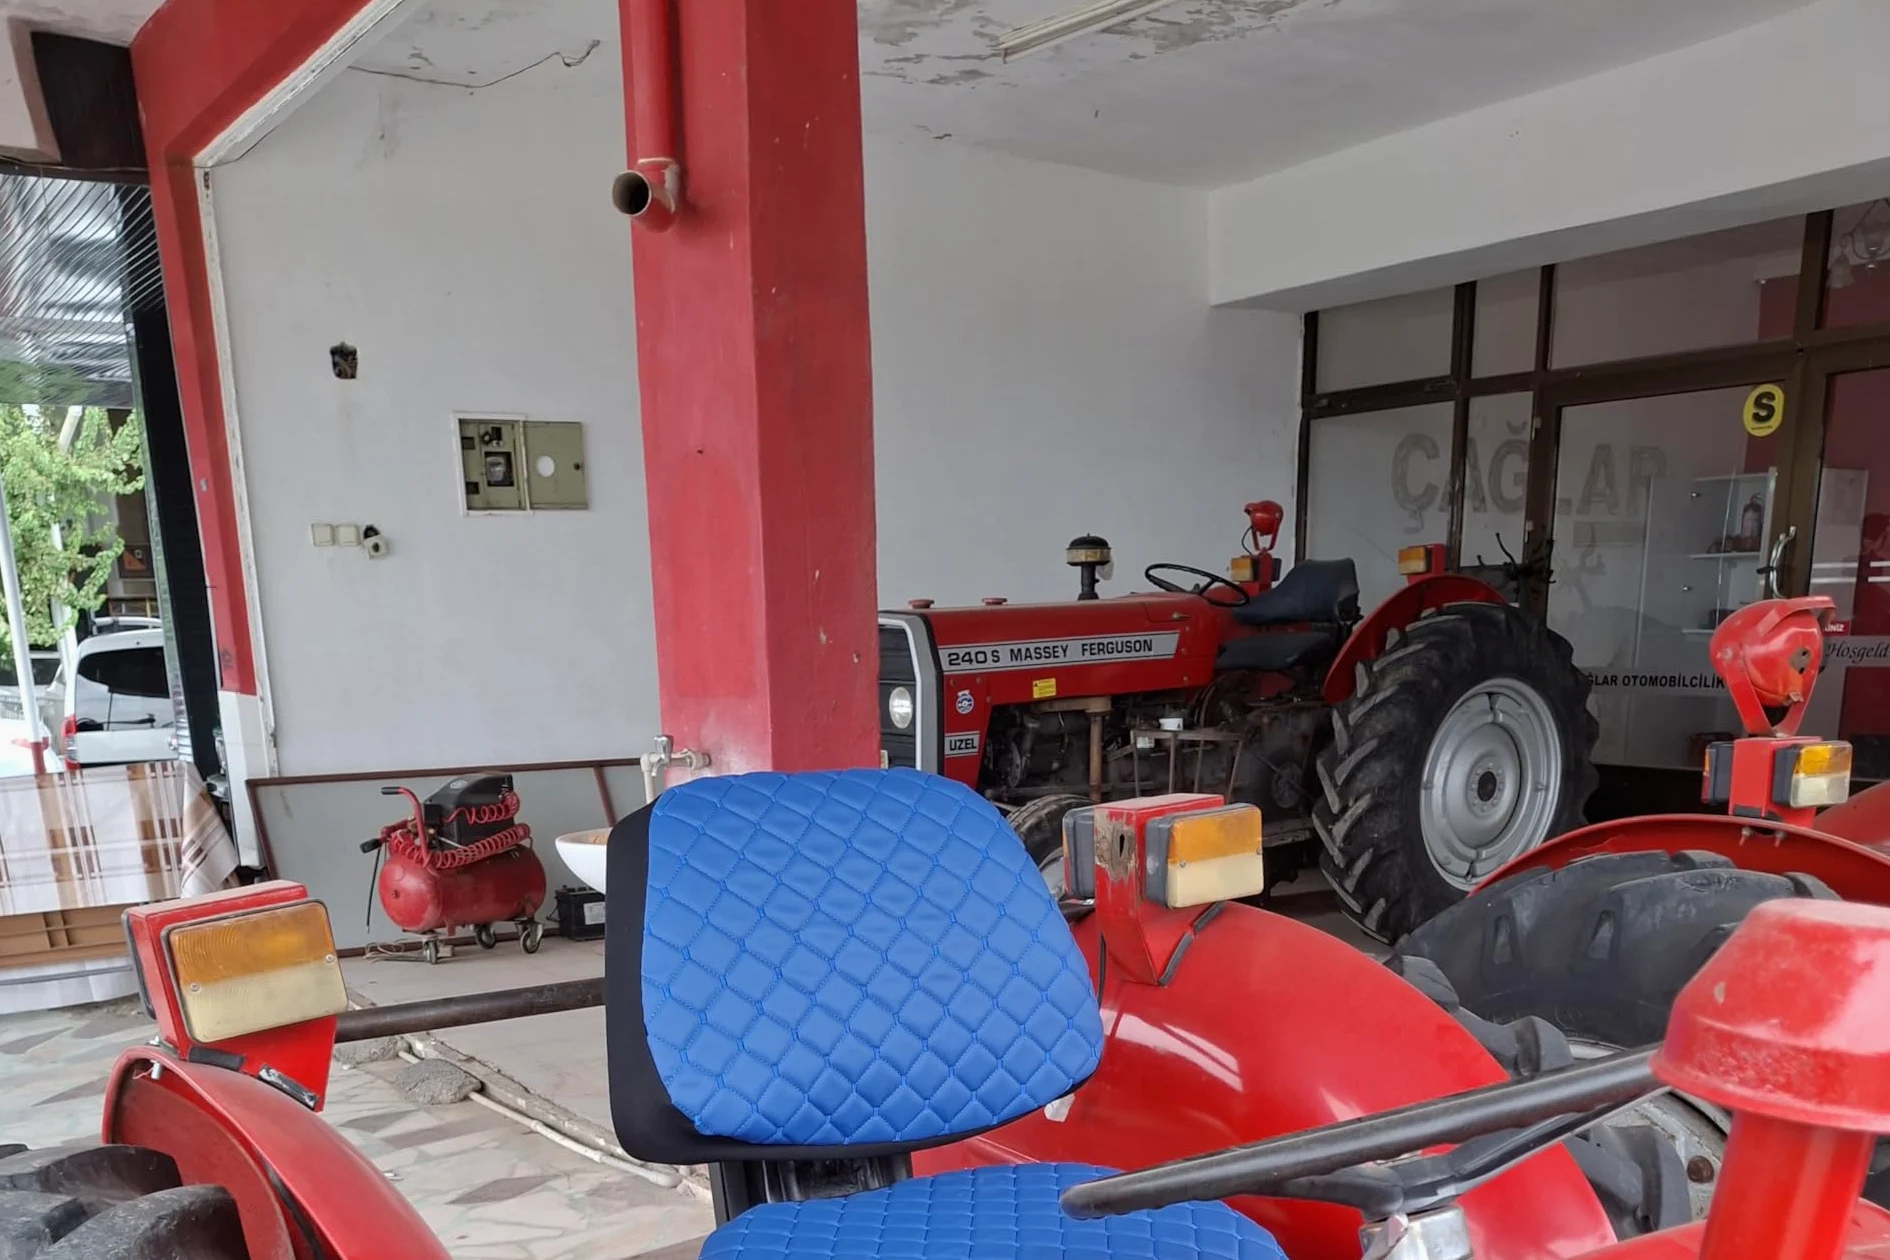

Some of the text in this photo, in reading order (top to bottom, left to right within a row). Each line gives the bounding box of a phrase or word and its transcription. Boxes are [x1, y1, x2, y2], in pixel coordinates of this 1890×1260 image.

[1752, 391, 1776, 424] S
[1391, 420, 1667, 534] ÇAĞAR
[1010, 644, 1069, 662] MASSEY
[1082, 639, 1153, 656] FERGUSON
[1622, 673, 1725, 689] OTOMOBİLCİLİK
[949, 738, 977, 751] UZEL
